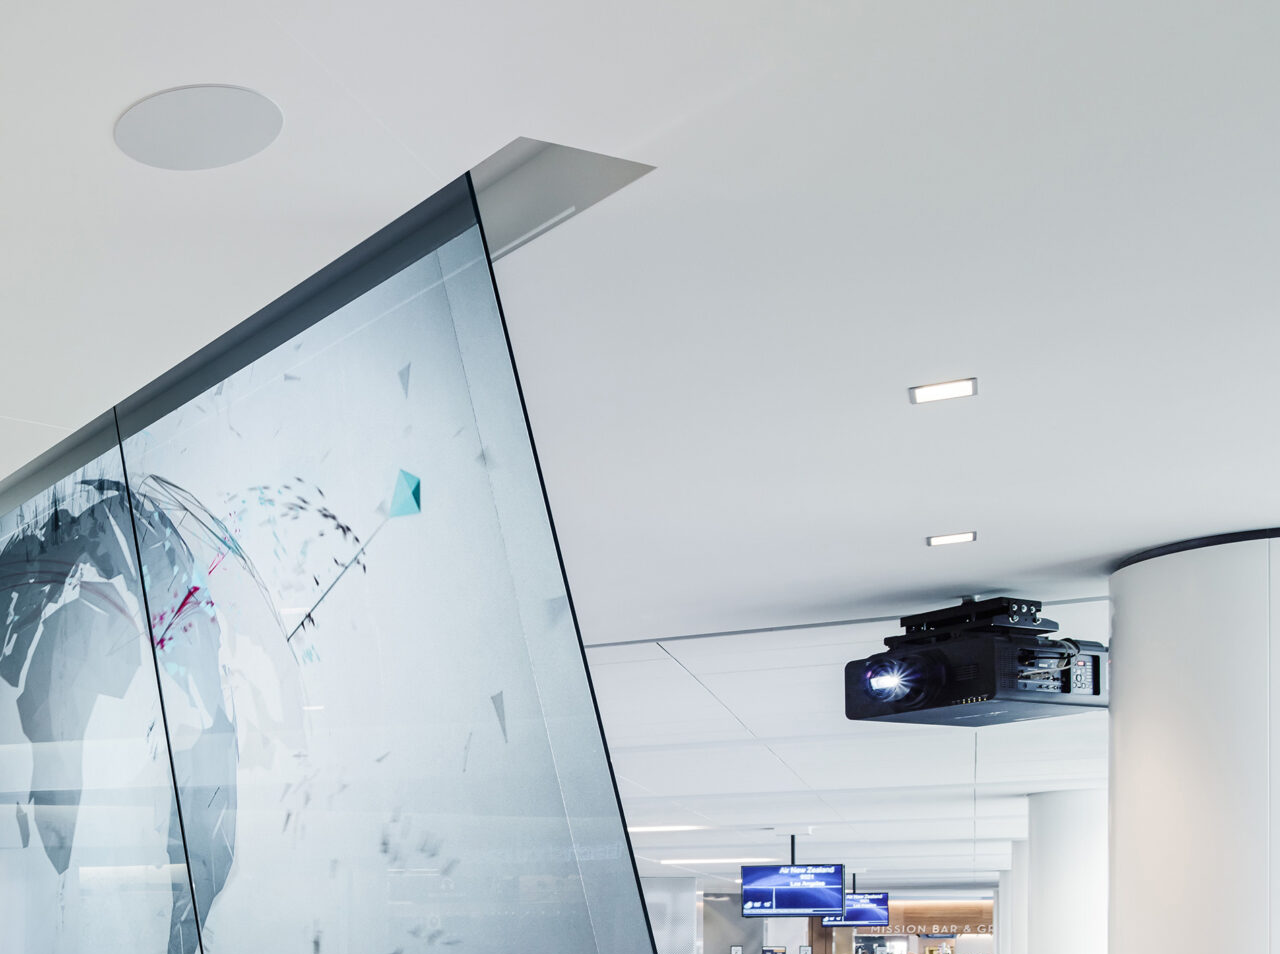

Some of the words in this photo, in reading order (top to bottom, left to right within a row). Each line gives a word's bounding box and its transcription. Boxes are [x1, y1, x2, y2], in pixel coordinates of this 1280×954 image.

[790, 866, 807, 874] New
[870, 925, 926, 933] MISSION
[932, 925, 958, 933] BAR
[963, 925, 971, 933] &
